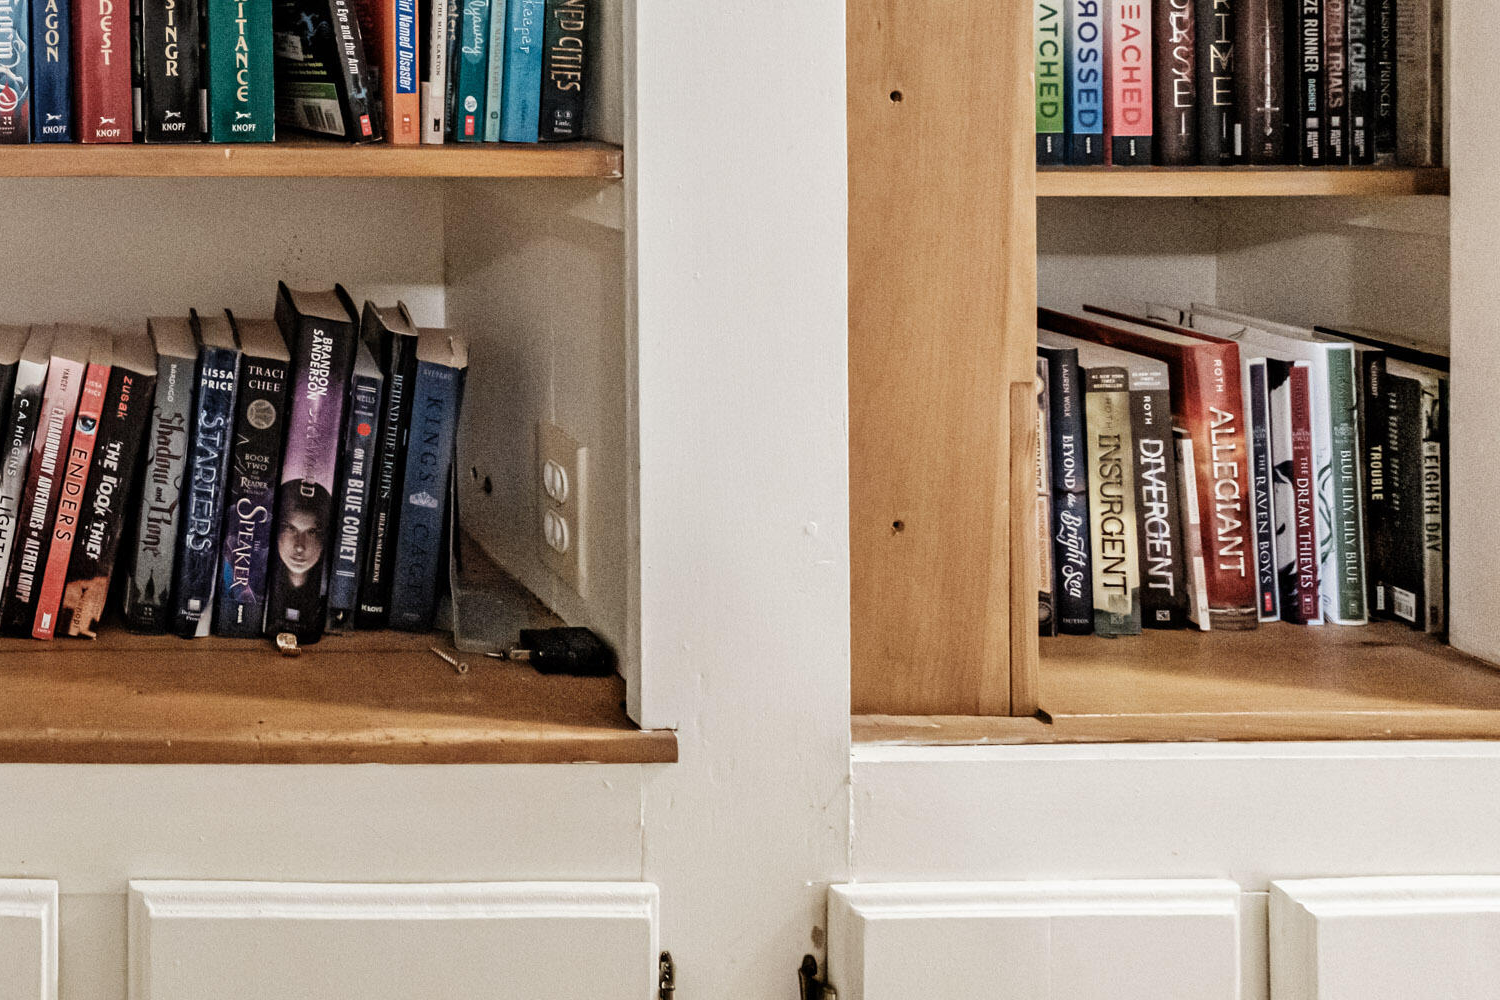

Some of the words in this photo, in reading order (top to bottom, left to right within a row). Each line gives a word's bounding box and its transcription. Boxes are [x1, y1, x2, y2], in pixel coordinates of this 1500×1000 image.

[399, 15, 411, 50] Named
[1303, 17, 1319, 72] RUNNER
[399, 51, 411, 91] Disaster
[551, 36, 583, 92] CITIES
[42, 125, 67, 134] KNOPF
[201, 379, 233, 391] PRICE
[202, 367, 234, 380] LISSA
[248, 365, 285, 379] TRACI
[248, 379, 281, 392] CHEE
[307, 328, 324, 401] SANDERSON
[321, 337, 333, 396] BRANDON
[1213, 359, 1223, 393] ROTH
[352, 460, 363, 476] THE
[353, 448, 365, 460] ON
[1300, 456, 1309, 474] THE
[56, 449, 87, 541] ENDERS
[186, 411, 225, 552] STARTERS
[345, 478, 364, 513] BLUE
[1208, 405, 1246, 578] ALLEGIANT
[1298, 477, 1310, 525] DREAM
[340, 513, 361, 563] COMET
[1098, 433, 1126, 595] INSURGENT
[1138, 439, 1174, 596] DIVERGENT
[230, 497, 268, 588] SPEAKER
[1299, 531, 1311, 589] THIEVES
